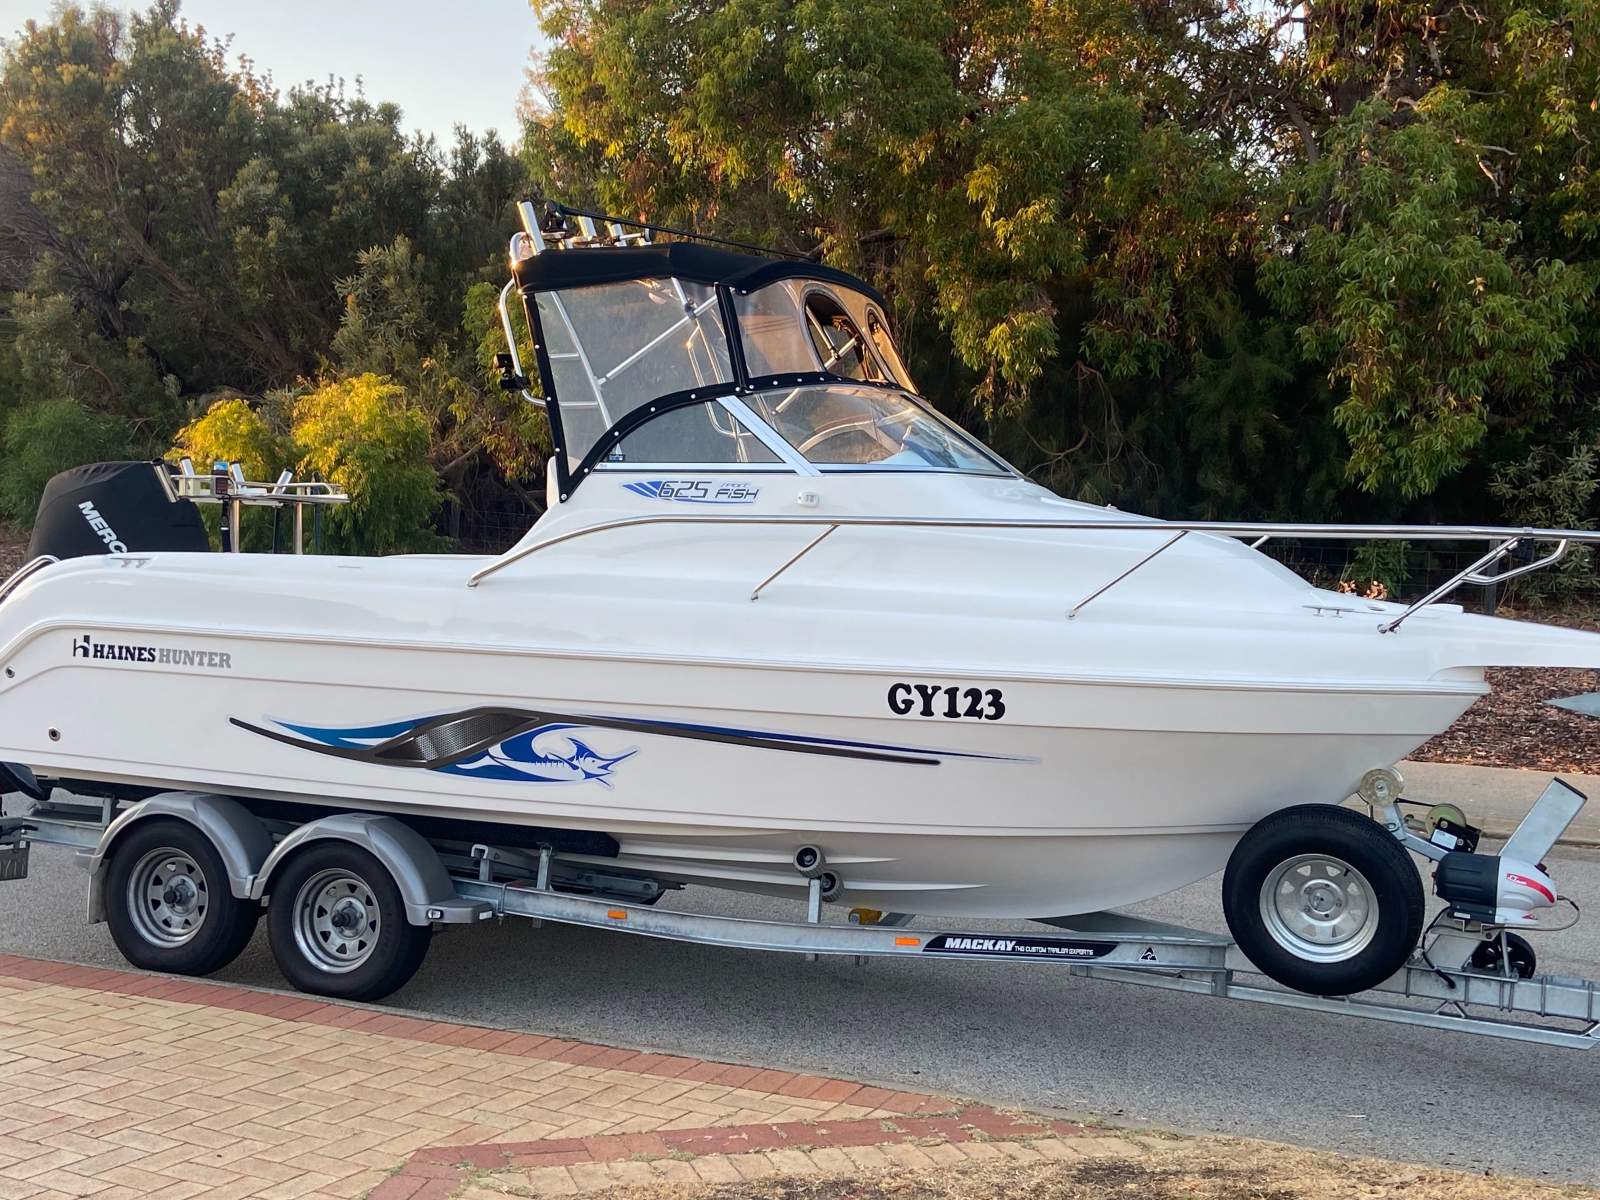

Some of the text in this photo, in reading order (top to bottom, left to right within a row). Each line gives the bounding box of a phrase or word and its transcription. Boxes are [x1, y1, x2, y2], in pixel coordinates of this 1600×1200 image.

[658, 480, 712, 499] 625
[78, 500, 128, 553] MERC
[92, 643, 232, 669] HAINES HUNTER
[887, 682, 1006, 721] GY123
[944, 937, 1017, 952] MACKAY
